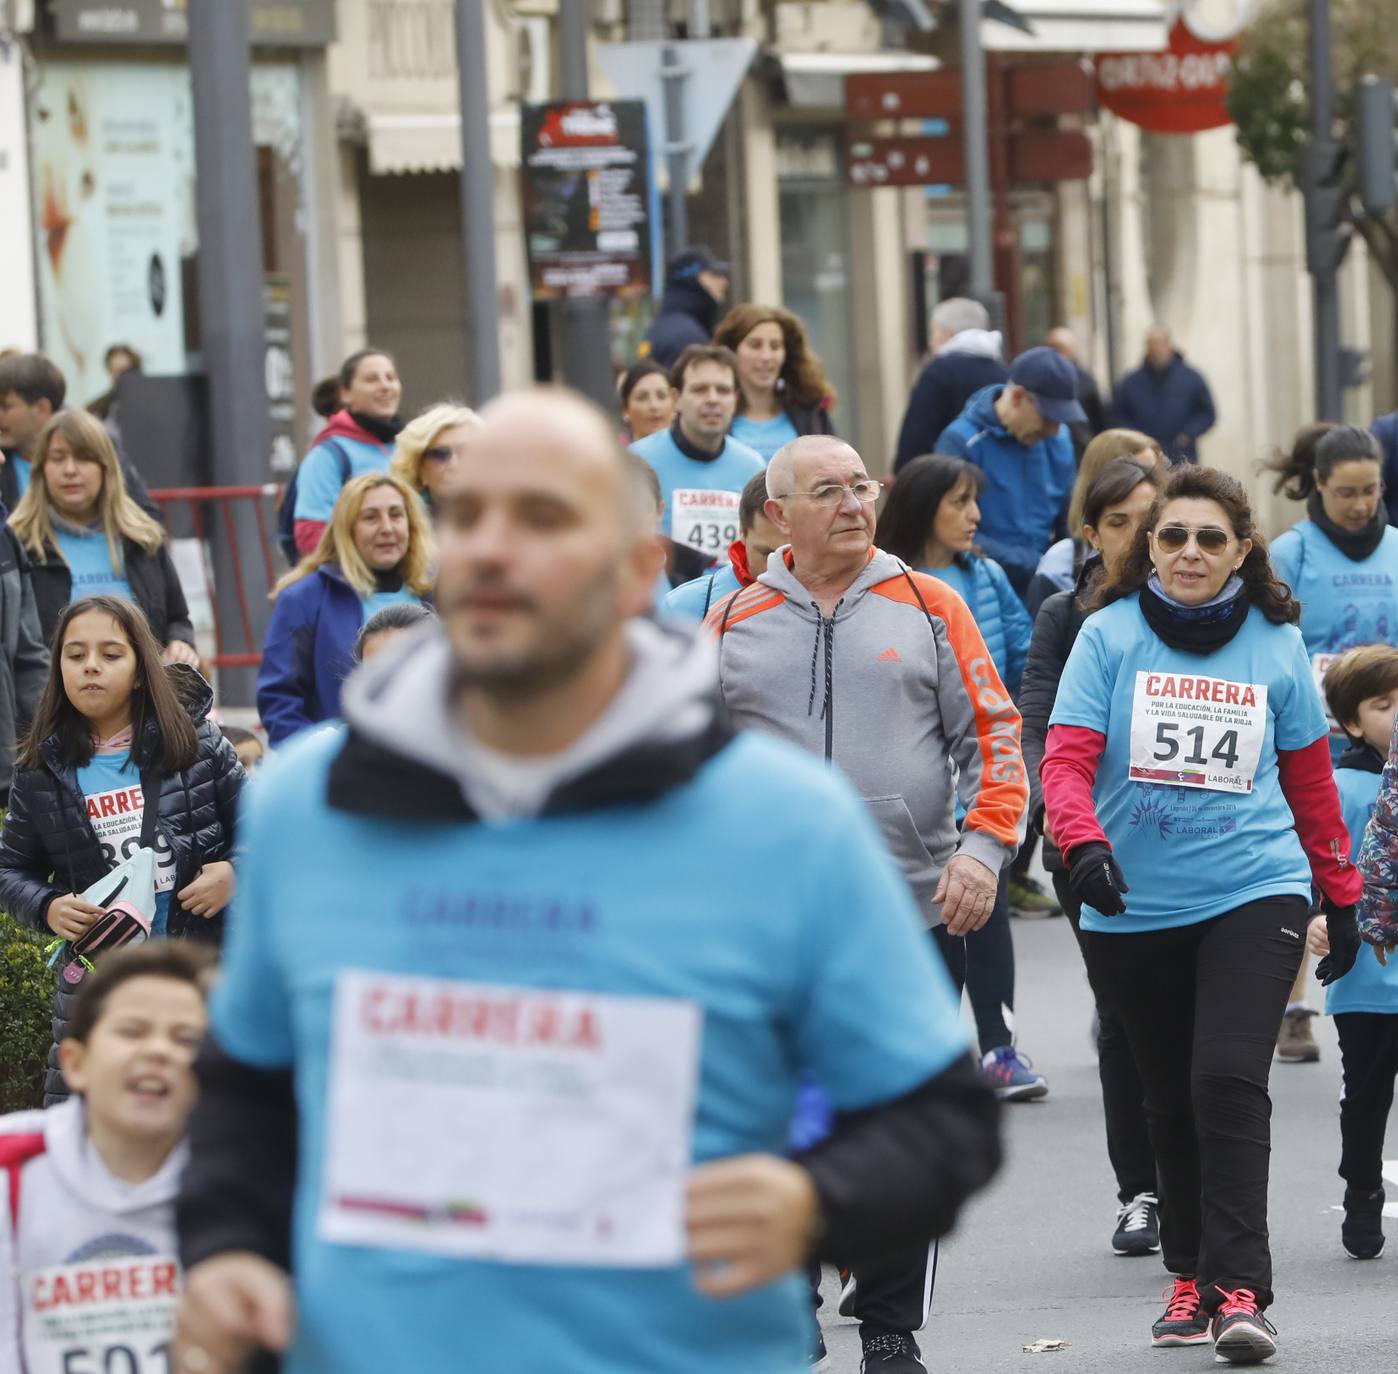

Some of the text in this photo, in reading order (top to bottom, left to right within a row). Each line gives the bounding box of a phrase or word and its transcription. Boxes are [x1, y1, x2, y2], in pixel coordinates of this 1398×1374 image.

[679, 493, 738, 508] CARRER
[688, 522, 737, 550] 439
[1146, 675, 1256, 708] CARRERA
[1151, 701, 1164, 709] POR
[1223, 708, 1248, 717] FAMILIA
[1177, 711, 1214, 722] SALUDABLE
[1215, 715, 1223, 723] DE
[1224, 715, 1233, 723] LA
[1233, 717, 1252, 726] RIOJA
[1153, 722, 1239, 769] 514
[1207, 774, 1242, 786] LABORAL
[86, 788, 145, 819] ARRE
[93, 823, 101, 831] LA
[1176, 826, 1218, 834] LABORAL
[360, 984, 605, 1054] CARRERA
[33, 1262, 177, 1312] CARRER
